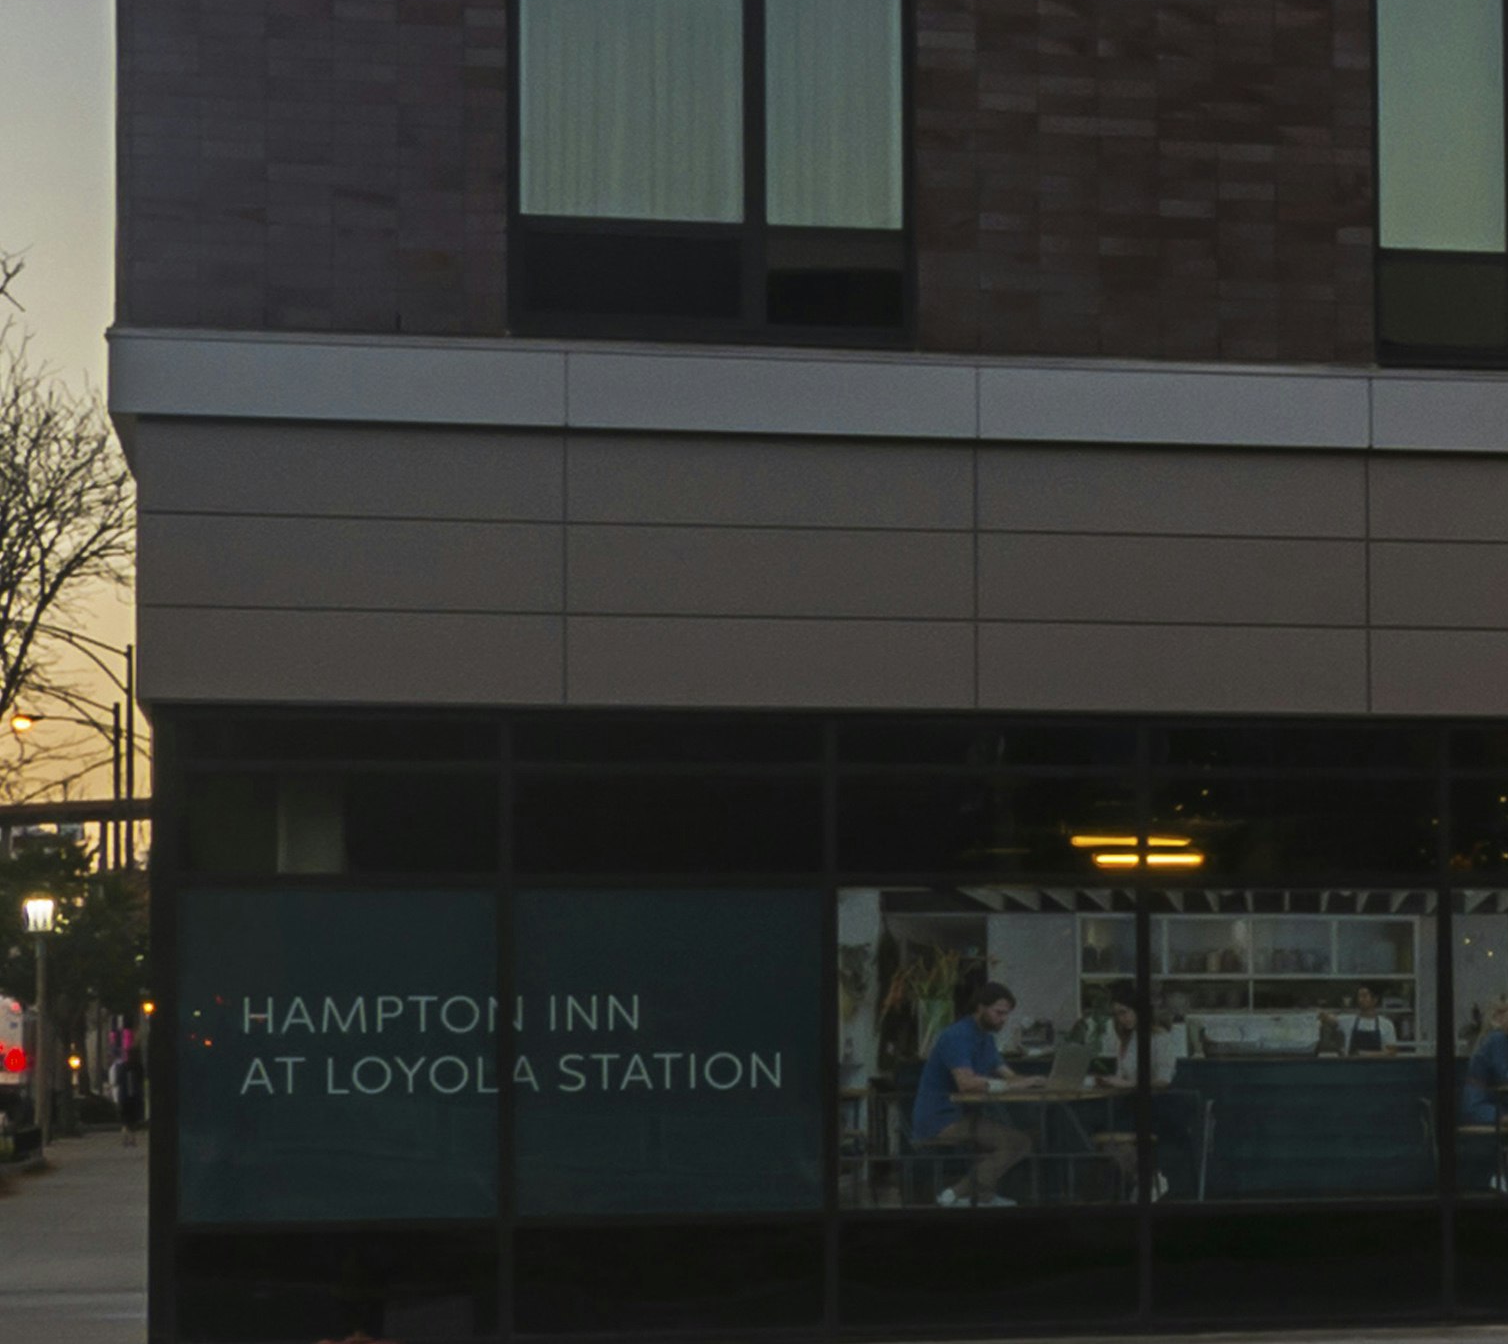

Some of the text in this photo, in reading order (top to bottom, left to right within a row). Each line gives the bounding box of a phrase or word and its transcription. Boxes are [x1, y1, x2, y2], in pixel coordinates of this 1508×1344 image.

[243, 994, 640, 1034] HAMPTON INN
[240, 1052, 784, 1095] AT LOYOLA STATION
